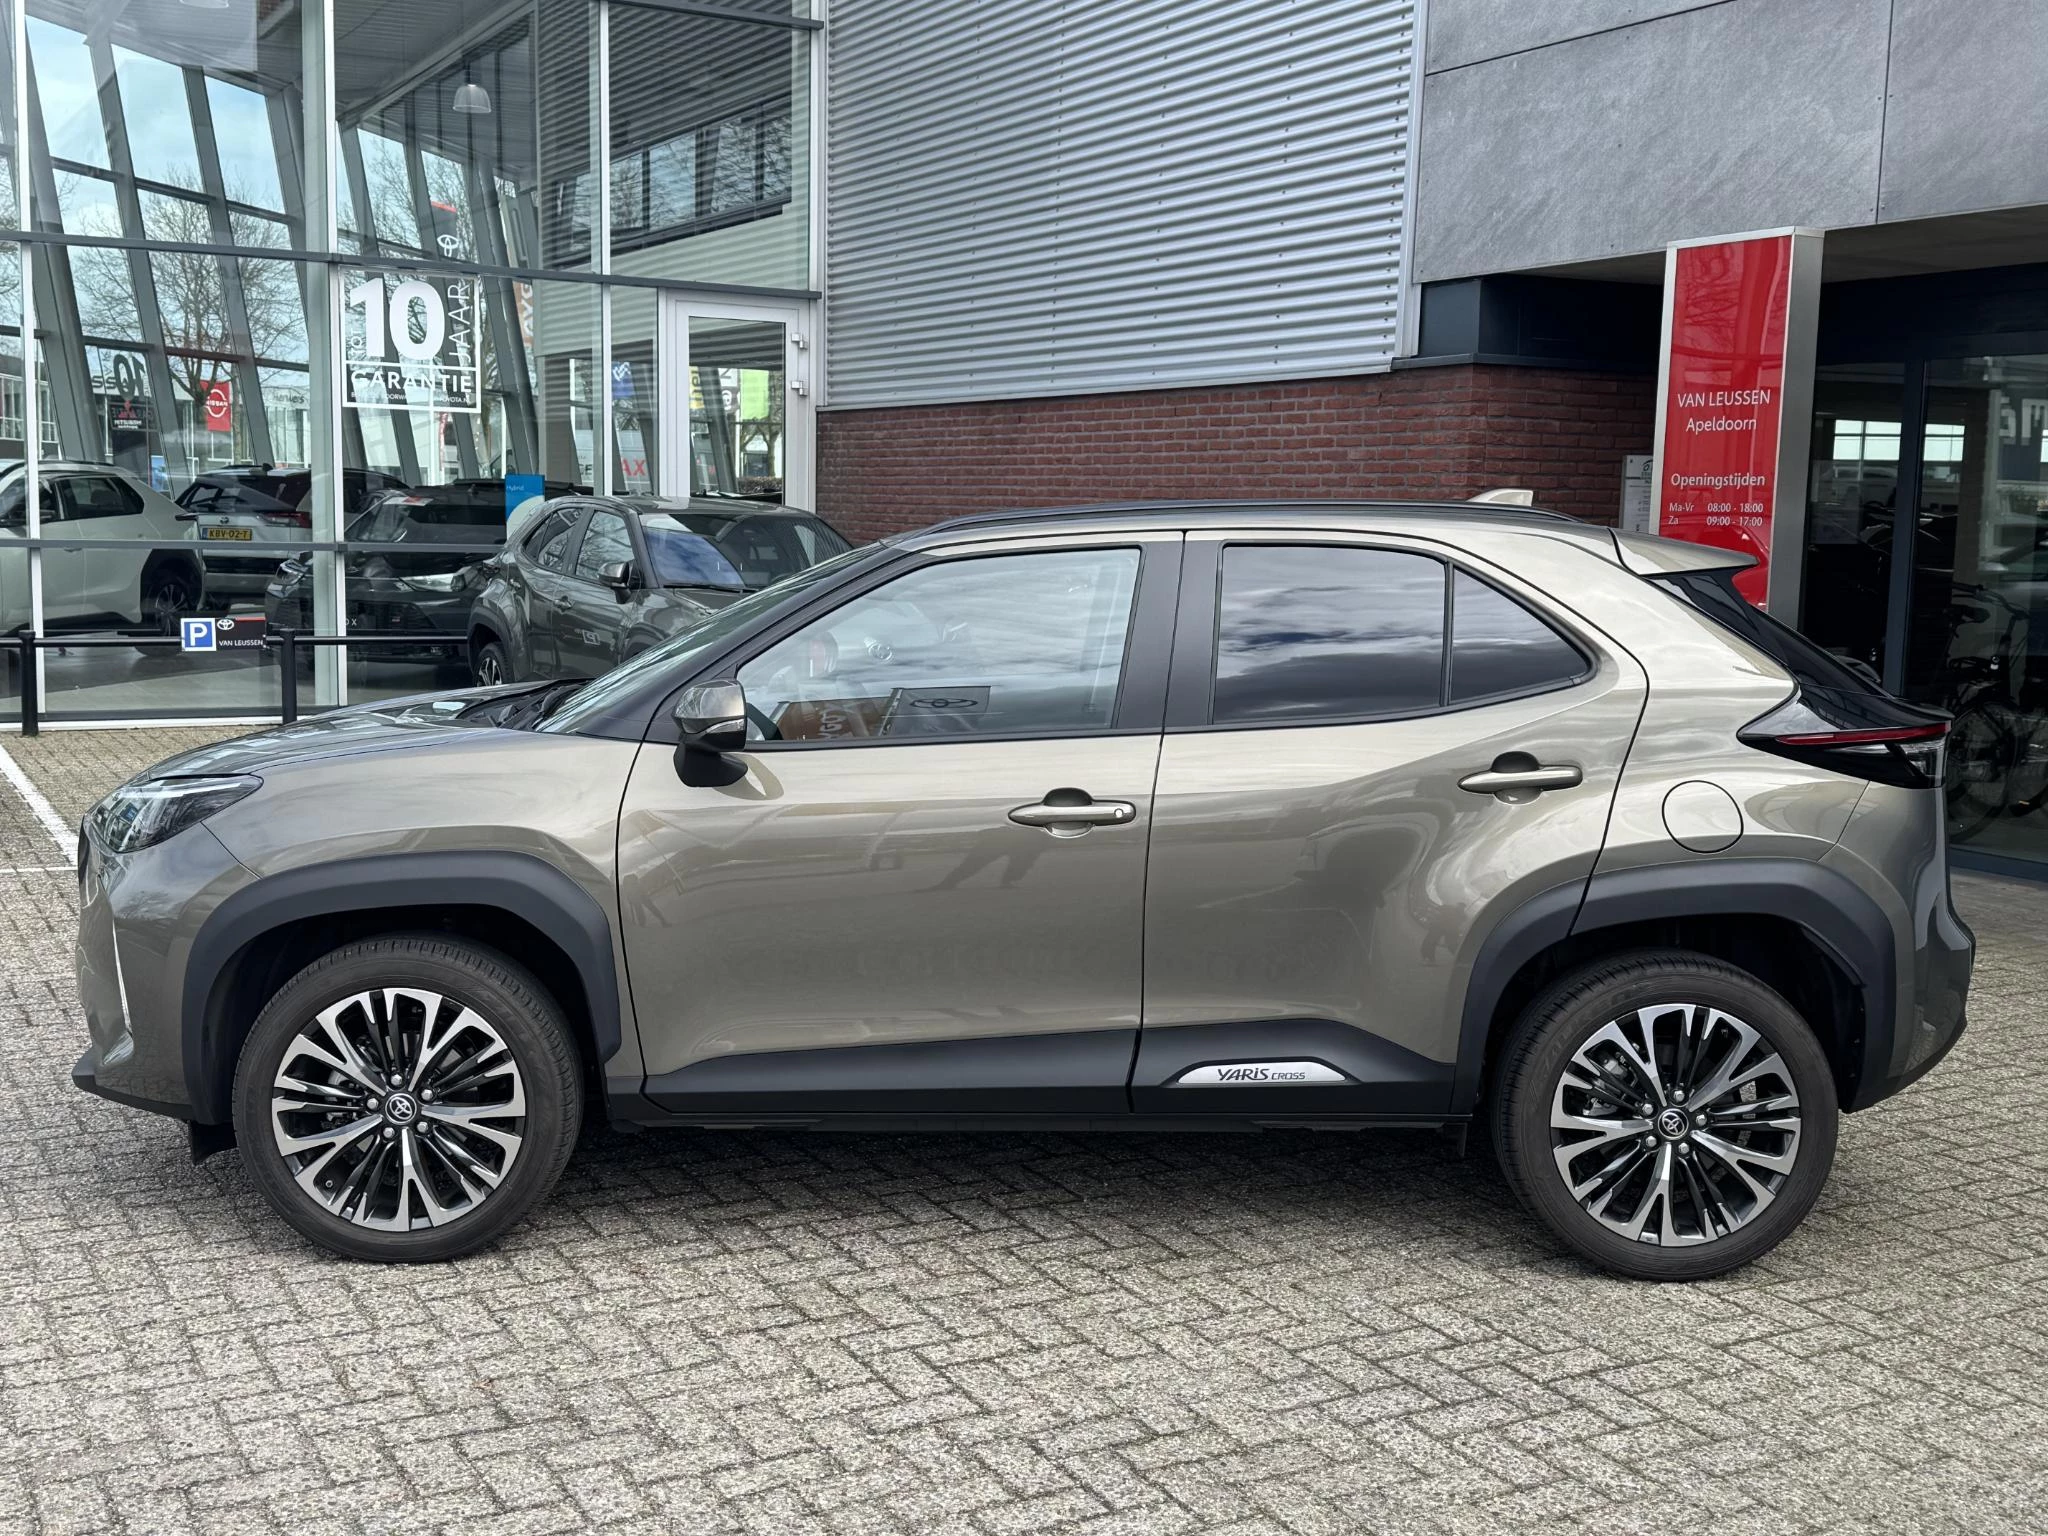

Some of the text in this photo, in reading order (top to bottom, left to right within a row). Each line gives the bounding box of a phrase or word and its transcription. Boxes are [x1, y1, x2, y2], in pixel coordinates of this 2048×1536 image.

[349, 277, 445, 360] 10
[447, 284, 472, 363] JAAR
[350, 370, 472, 393] GARANTIE
[1677, 389, 1771, 408] VAN LEUSSEN
[1686, 416, 1757, 435] Apeldoorn
[1671, 472, 1765, 490] Openingstijden
[1669, 502, 1694, 512] Ma-Vr
[1707, 502, 1731, 513] 08:00
[1740, 502, 1763, 513] 18:00
[1668, 515, 1679, 525] Za
[1706, 516, 1730, 526] 09:00
[1739, 516, 1763, 527] 17:00
[209, 528, 249, 539] KBV-02-T
[189, 622, 208, 647] P
[218, 639, 264, 647] VAN LEUSSEN
[1272, 1072, 1306, 1081] CROSS
